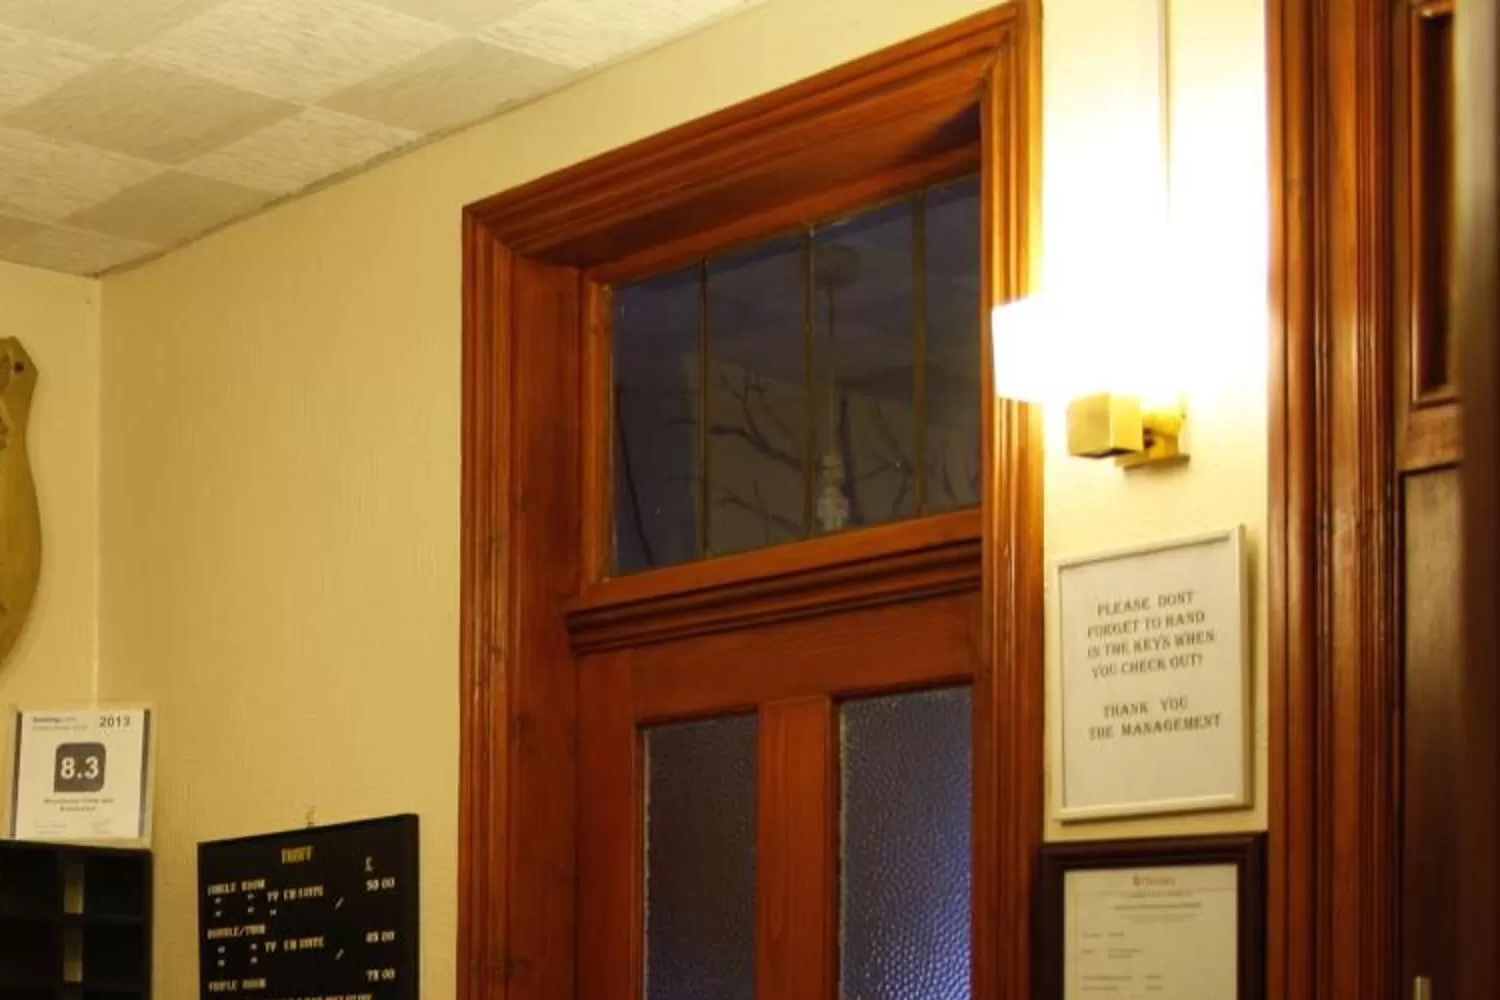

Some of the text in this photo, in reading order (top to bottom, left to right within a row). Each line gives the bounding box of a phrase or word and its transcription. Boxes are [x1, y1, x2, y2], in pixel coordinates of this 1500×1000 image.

[1097, 597, 1150, 617] PLEASE
[1087, 611, 1205, 638] FORGET TO HAND
[1087, 646, 1100, 658] IN
[1104, 642, 1128, 656] THE
[1174, 628, 1216, 647] WHEN
[1092, 663, 1117, 679] YOU
[1121, 658, 1167, 675] CHECK
[1103, 695, 1189, 718] THANK YOU
[100, 715, 131, 728] 2013
[1088, 711, 1222, 741] THE MANAGEMENT
[60, 756, 99, 780] 8.3
